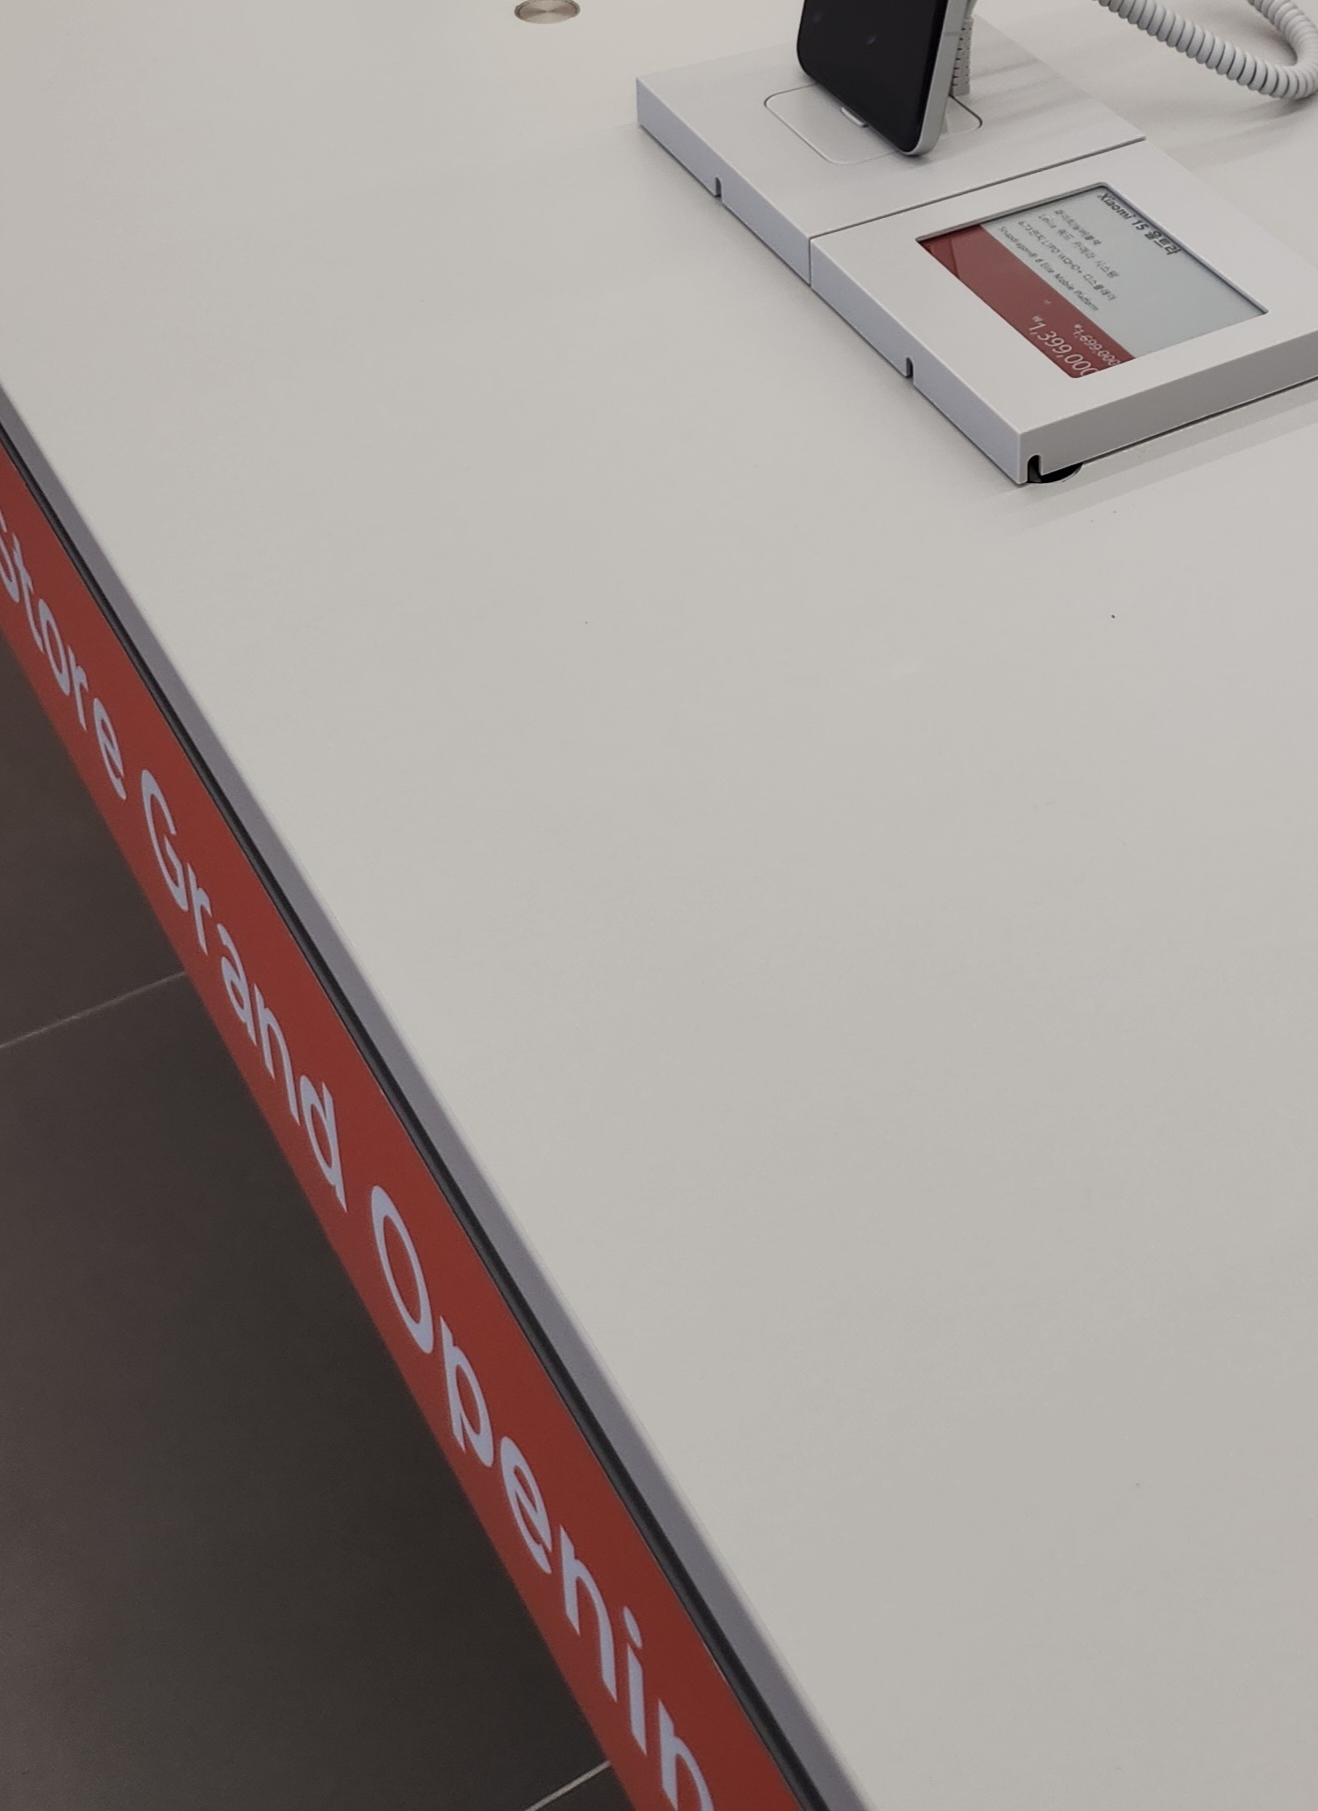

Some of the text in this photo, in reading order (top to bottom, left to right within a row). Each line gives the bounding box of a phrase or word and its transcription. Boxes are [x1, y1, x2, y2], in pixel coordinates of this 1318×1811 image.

[1095, 191, 1137, 220] Xiaomi
[1130, 219, 1149, 231] 15
[1143, 228, 1184, 256] 울트라
[141, 769, 348, 1214] Grand
[371, 1185, 714, 1811] Openin
